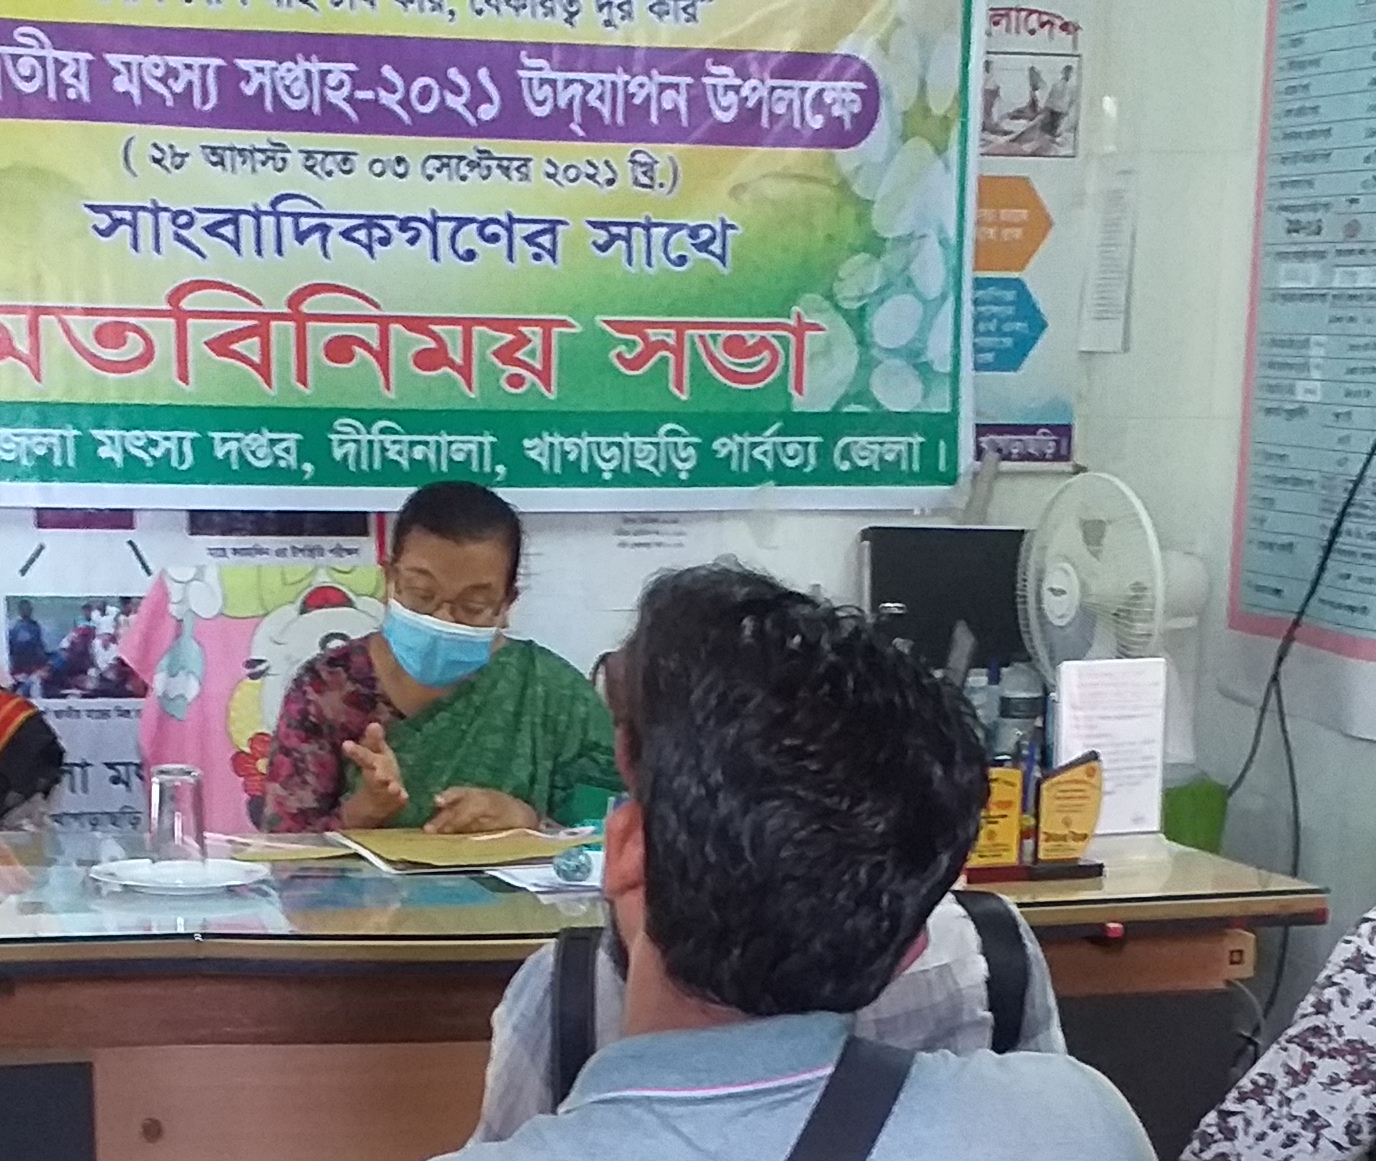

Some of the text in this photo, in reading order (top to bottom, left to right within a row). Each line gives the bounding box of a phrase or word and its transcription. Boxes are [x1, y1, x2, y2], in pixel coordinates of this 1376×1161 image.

[103, 52, 227, 112] মৎস্য
[233, 52, 502, 127] সপ্তাহ-২০২১
[702, 58, 868, 131] উপলক্ষে
[199, 137, 292, 175] আগস্ট
[298, 148, 359, 180] হতে
[368, 155, 411, 179] ০৩
[421, 145, 534, 183] সেপ্টেম্বর
[544, 157, 619, 189] ২০২১
[85, 192, 738, 270] সাংবাদিকগণের সাথে
[597, 307, 827, 399] সভা
[89, 427, 201, 471] মৎস্য
[208, 429, 315, 480] দপ্তর,
[329, 418, 508, 482] দীঘিনালা,
[522, 423, 703, 480] খাগড়াছড়ি
[711, 422, 824, 475] পার্বত্য
[833, 431, 927, 473] জেলা
